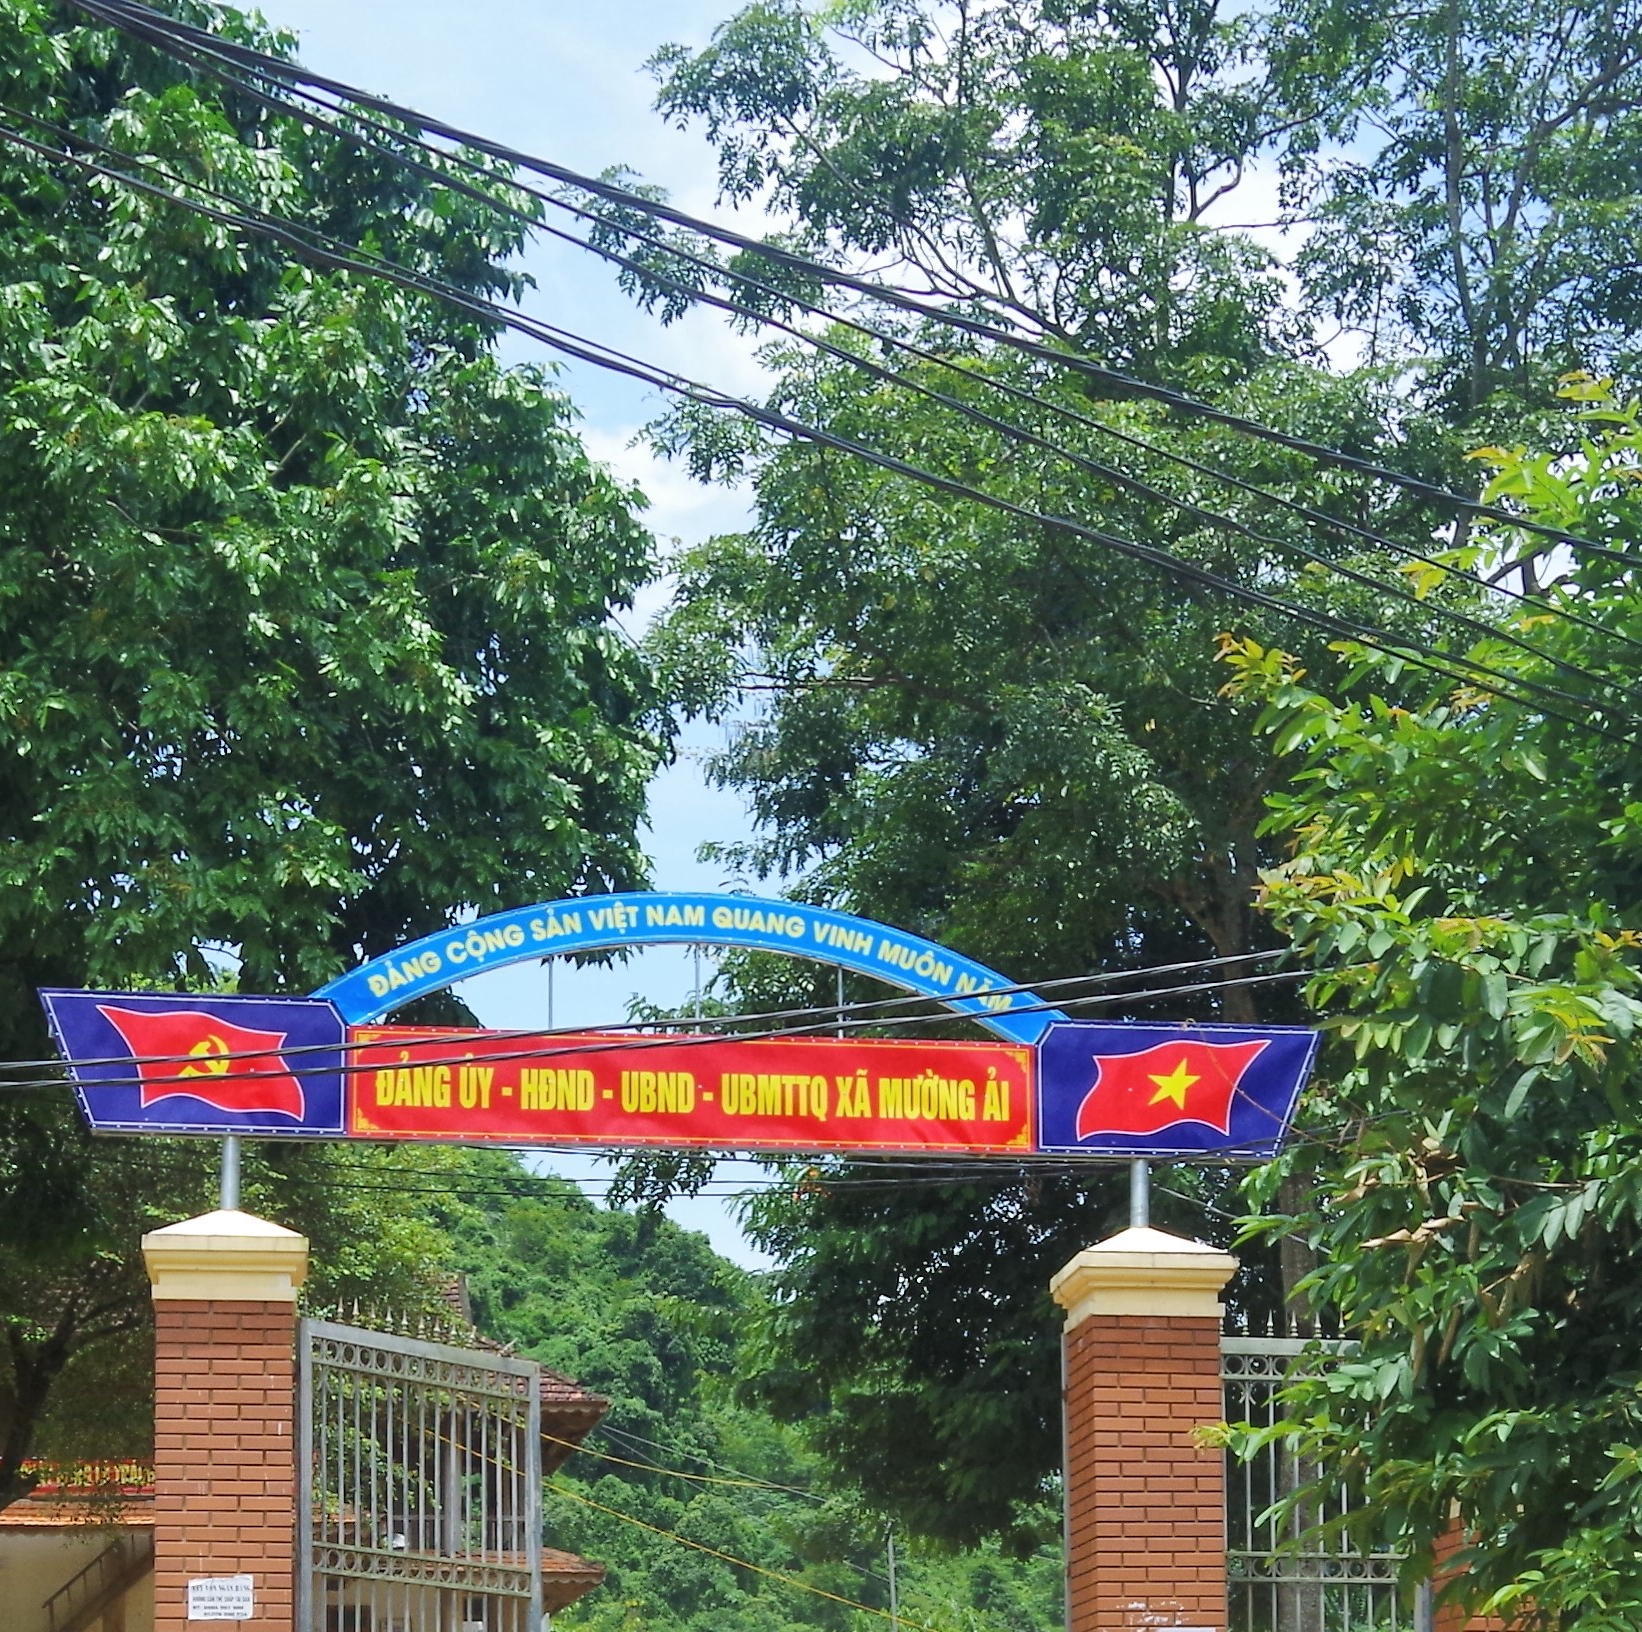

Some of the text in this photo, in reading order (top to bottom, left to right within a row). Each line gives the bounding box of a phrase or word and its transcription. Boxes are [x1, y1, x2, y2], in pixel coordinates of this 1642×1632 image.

[367, 901, 1013, 1012] ĐẢNG CỘNG SẢN VIỆT NAM QUANG VINH MUÔN NĂM
[375, 1051, 451, 1108] ĐẢNG
[459, 1052, 495, 1109] ỦY
[521, 1068, 595, 1111] HĐND
[621, 1070, 695, 1113] UBND
[721, 1073, 828, 1122] UBMTTQ
[835, 1069, 872, 1119] XÃ
[879, 1069, 976, 1121] MƯỜNG
[983, 1066, 1010, 1122] ẢI
